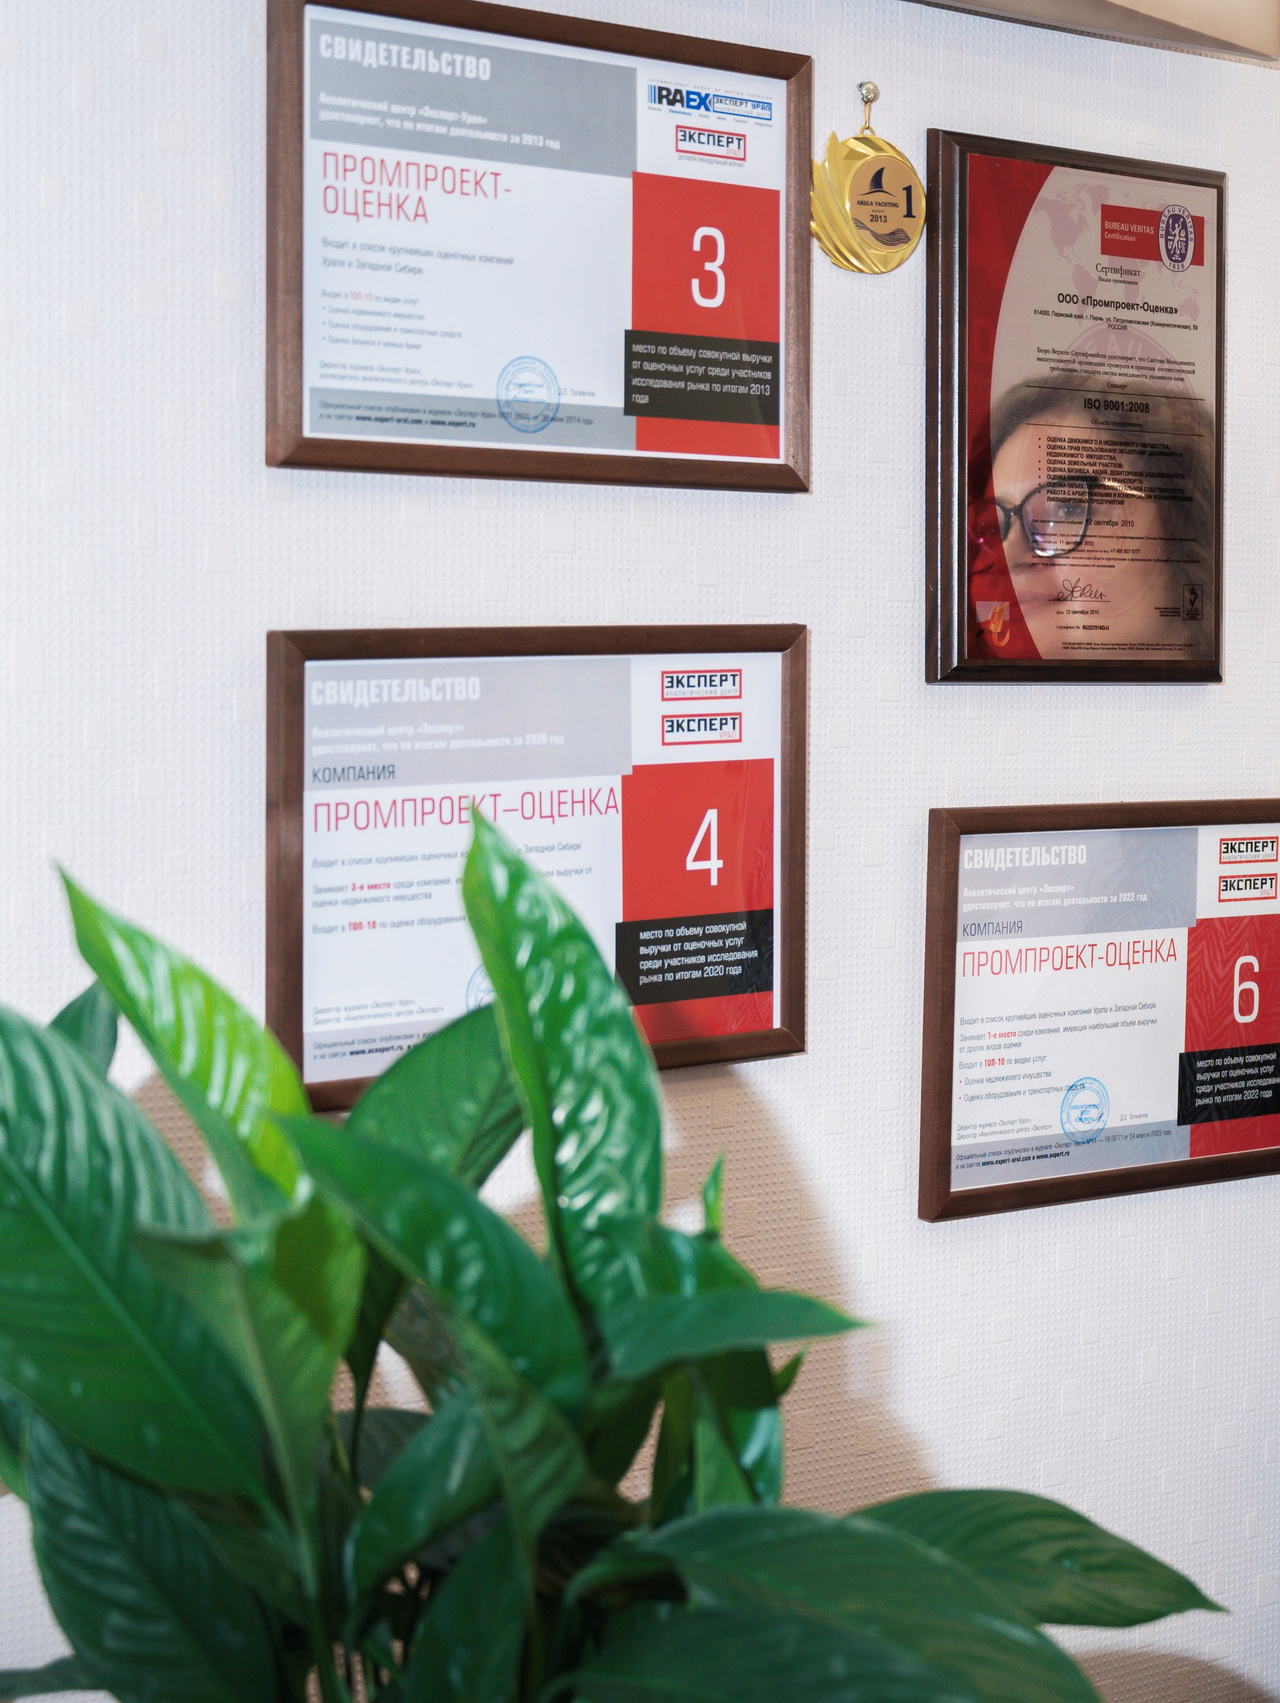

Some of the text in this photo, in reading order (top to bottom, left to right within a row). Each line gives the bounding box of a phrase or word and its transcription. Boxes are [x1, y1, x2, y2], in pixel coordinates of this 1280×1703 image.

[319, 35, 491, 79] СВИДЕТЕЛЬСТВО
[657, 86, 711, 112] RAEX
[714, 97, 749, 108] ЭКСПЕРТ
[751, 102, 771, 112] УРАЛ
[678, 129, 743, 150] ЭКСПЕРТ
[726, 148, 742, 157] УРАЛ
[323, 152, 512, 199] ПРОМПРОЕКТ-
[323, 185, 428, 223] ОЦЕНКА
[902, 184, 916, 218] 1
[870, 214, 887, 223] 2013
[1159, 207, 1194, 243] BUREAU VERITAS
[1104, 221, 1154, 235] BUREAU VERITAS
[1104, 232, 1136, 242] Certification
[691, 226, 726, 308] 3
[1095, 262, 1141, 277] Сертификат
[1168, 262, 1185, 270] 1828
[1057, 292, 1177, 314] ООО «Промпроект-Оценка»
[632, 343, 655, 353] место
[668, 345, 696, 358] объему
[698, 349, 740, 360] совокупной
[742, 353, 772, 364] выручки
[642, 361, 684, 372] оценочных
[685, 365, 706, 376] услуг
[706, 366, 730, 376] среди
[730, 369, 772, 379] участников
[631, 377, 685, 388] исследования
[686, 381, 710, 391] рынка
[722, 384, 748, 393] итогам
[749, 383, 770, 395] 2013
[630, 393, 649, 403] года
[1084, 397, 1149, 413] ISO 9001:2008
[665, 674, 739, 689] ЭКСПЕРТ
[311, 677, 480, 705] СВИДЕТЕЛЬСТВО
[665, 717, 739, 733] ЭКСПЕРТ
[719, 731, 737, 740] УРАЛ
[311, 764, 395, 782] КОМПАНИЯ
[685, 808, 724, 886] 4
[1222, 840, 1276, 854] ЭКСПЕРТ
[963, 845, 1087, 871] СВИДЕТЕЛЬСТВО
[962, 883, 1074, 896] Аналитический центр «Эксперт»
[1221, 877, 1275, 892] ЭКСПЕРТ
[1260, 888, 1274, 896] УРАЛ
[963, 901, 1011, 912] удостоверяет,
[1013, 900, 1025, 908] что
[1037, 898, 1061, 906] итогам
[1062, 895, 1108, 906] деятельности
[1118, 891, 1135, 902] 2022
[1136, 893, 1147, 901] год
[639, 929, 663, 939] место
[675, 926, 703, 936] объему
[705, 920, 746, 933] совокупной
[962, 920, 1023, 936] КОМПАНИЯ
[638, 944, 671, 955] выручки
[682, 939, 723, 950] оценочных
[724, 936, 745, 948] услуг
[639, 949, 758, 970] среди участников исследования
[962, 938, 1178, 977] ПРОМПРОЕКТ-ОЦЕНКА
[638, 973, 663, 985] рынка
[675, 969, 702, 979] итогам
[702, 964, 724, 977] 2020
[725, 965, 742, 975] года
[1233, 955, 1260, 1024] 6
[1196, 1059, 1214, 1067] место
[1223, 1055, 1243, 1065] объему
[1245, 1051, 1276, 1062] совокупной
[1195, 1071, 1220, 1081] выручки
[1228, 1067, 1259, 1077] оценочных
[1259, 1064, 1275, 1075] услуг
[1195, 1084, 1213, 1094] среди
[1214, 1080, 1245, 1092] участников
[1195, 1096, 1213, 1107] рынка
[1222, 1093, 1242, 1102] итогам
[1242, 1089, 1259, 1099] 2022
[1259, 1089, 1272, 1098] года
